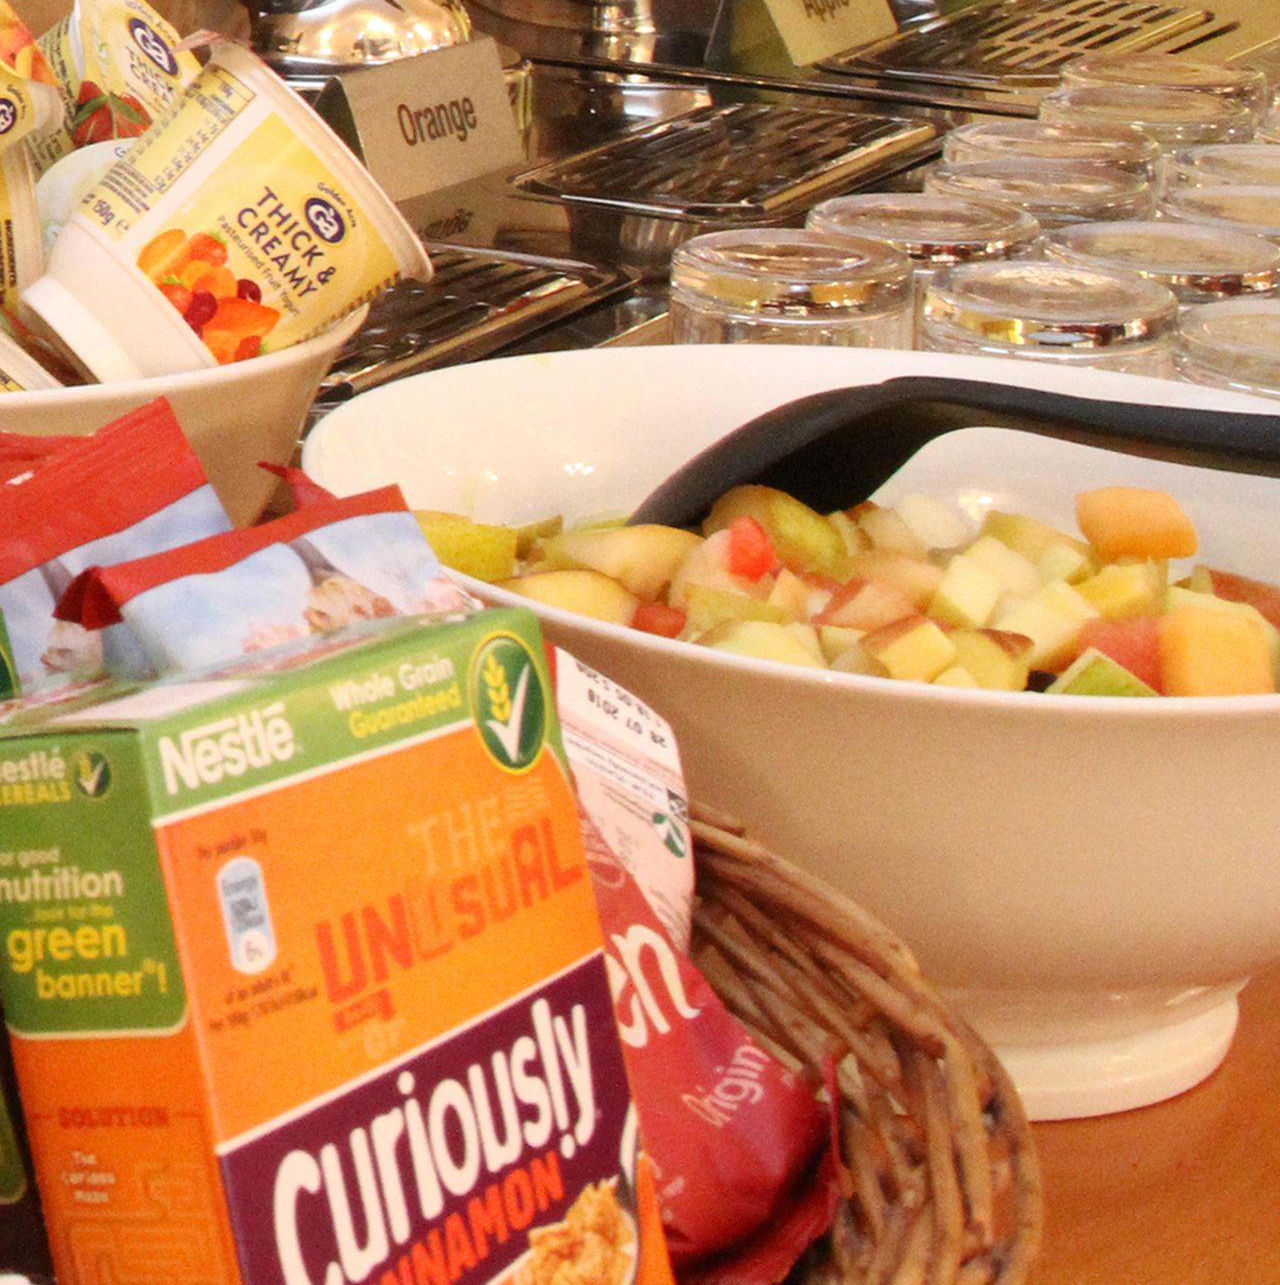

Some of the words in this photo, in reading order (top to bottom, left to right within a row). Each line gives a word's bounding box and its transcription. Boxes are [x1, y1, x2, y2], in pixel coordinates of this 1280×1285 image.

[397, 96, 477, 146] Orange
[216, 214, 266, 271] Pasteurised
[237, 207, 319, 298] CREAMY
[256, 186, 325, 267] THICK
[317, 265, 336, 286] &
[329, 672, 395, 712] Whole
[398, 655, 454, 691] Grain
[348, 683, 462, 739] Guaranteed
[19, 848, 61, 869] good
[408, 796, 499, 875] THE
[315, 816, 583, 1004] UNUSUAL
[7, 923, 128, 974] green
[681, 1035, 771, 1129] Origin
[274, 998, 596, 1285] Curiously
